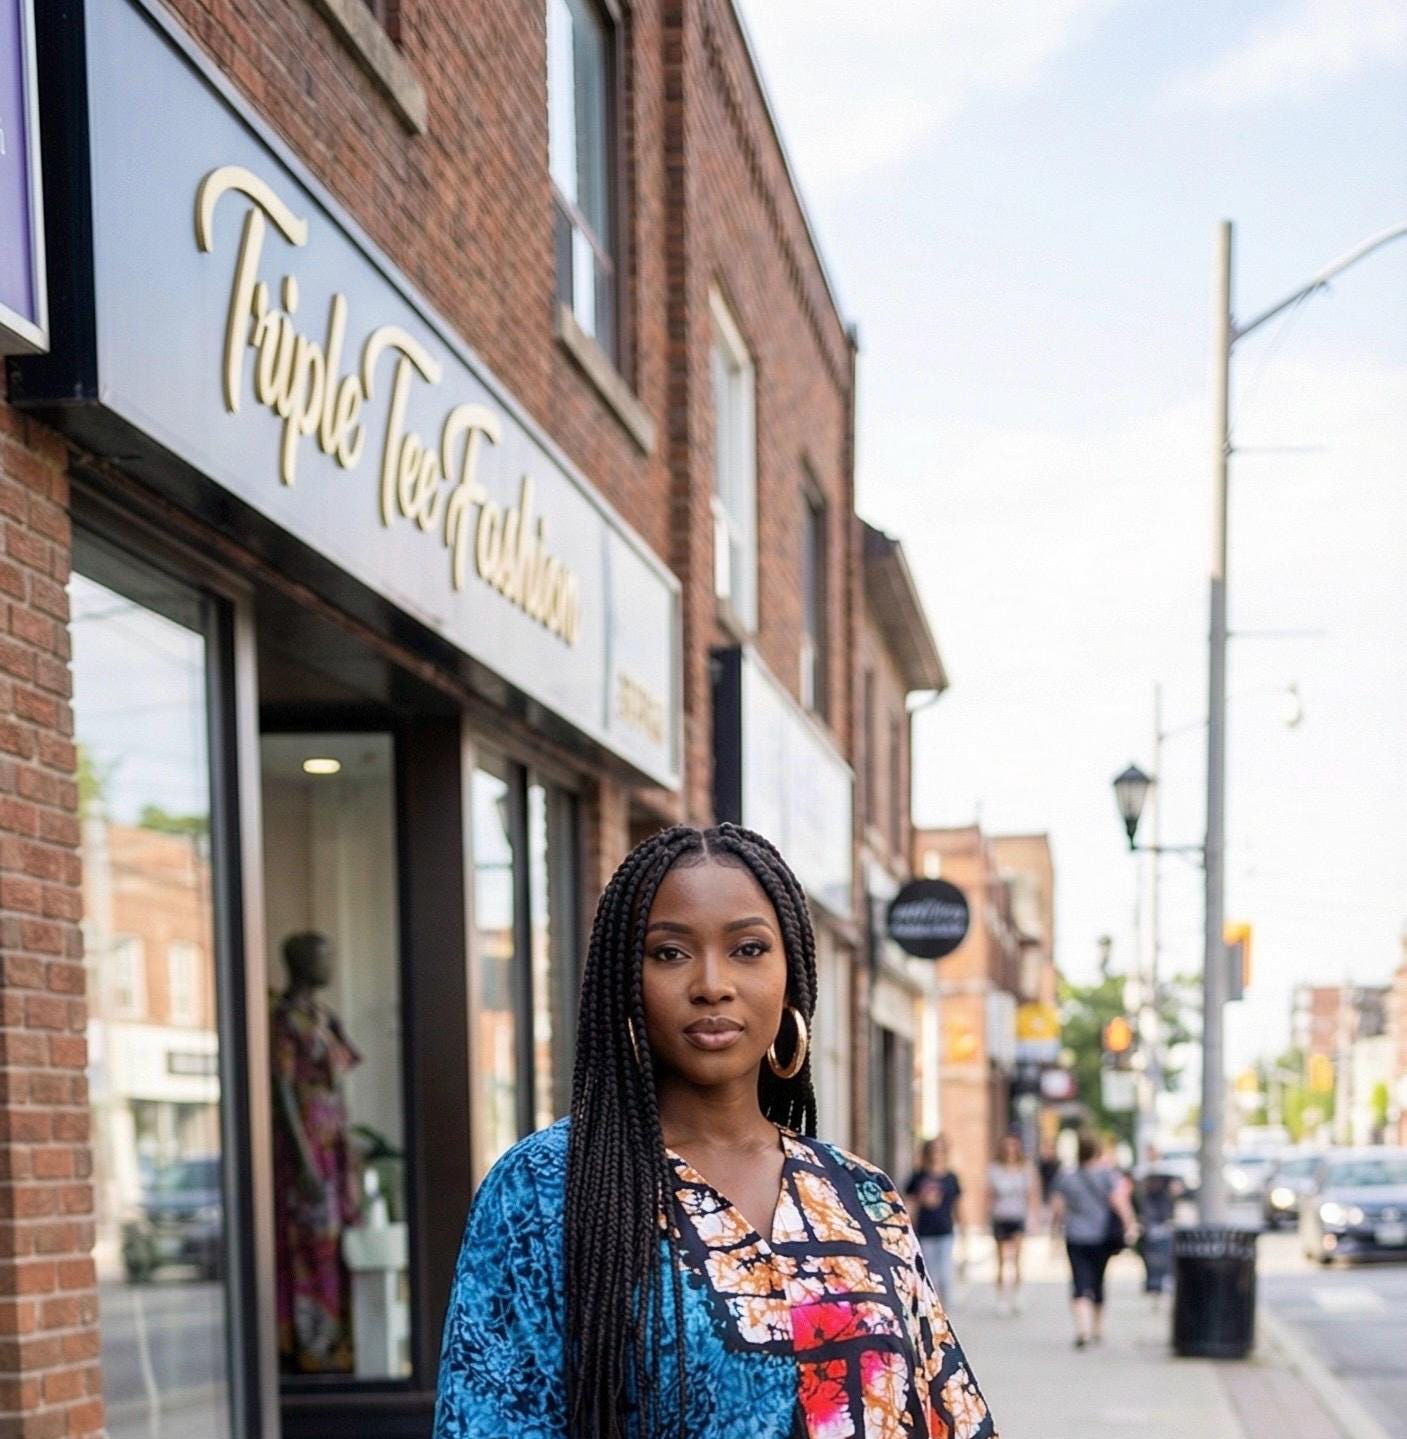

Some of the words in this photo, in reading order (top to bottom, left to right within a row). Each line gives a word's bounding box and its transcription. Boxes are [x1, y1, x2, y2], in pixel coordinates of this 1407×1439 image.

[194, 166, 365, 487] Triple
[362, 326, 441, 532] Tee
[442, 403, 580, 647] Fashion
